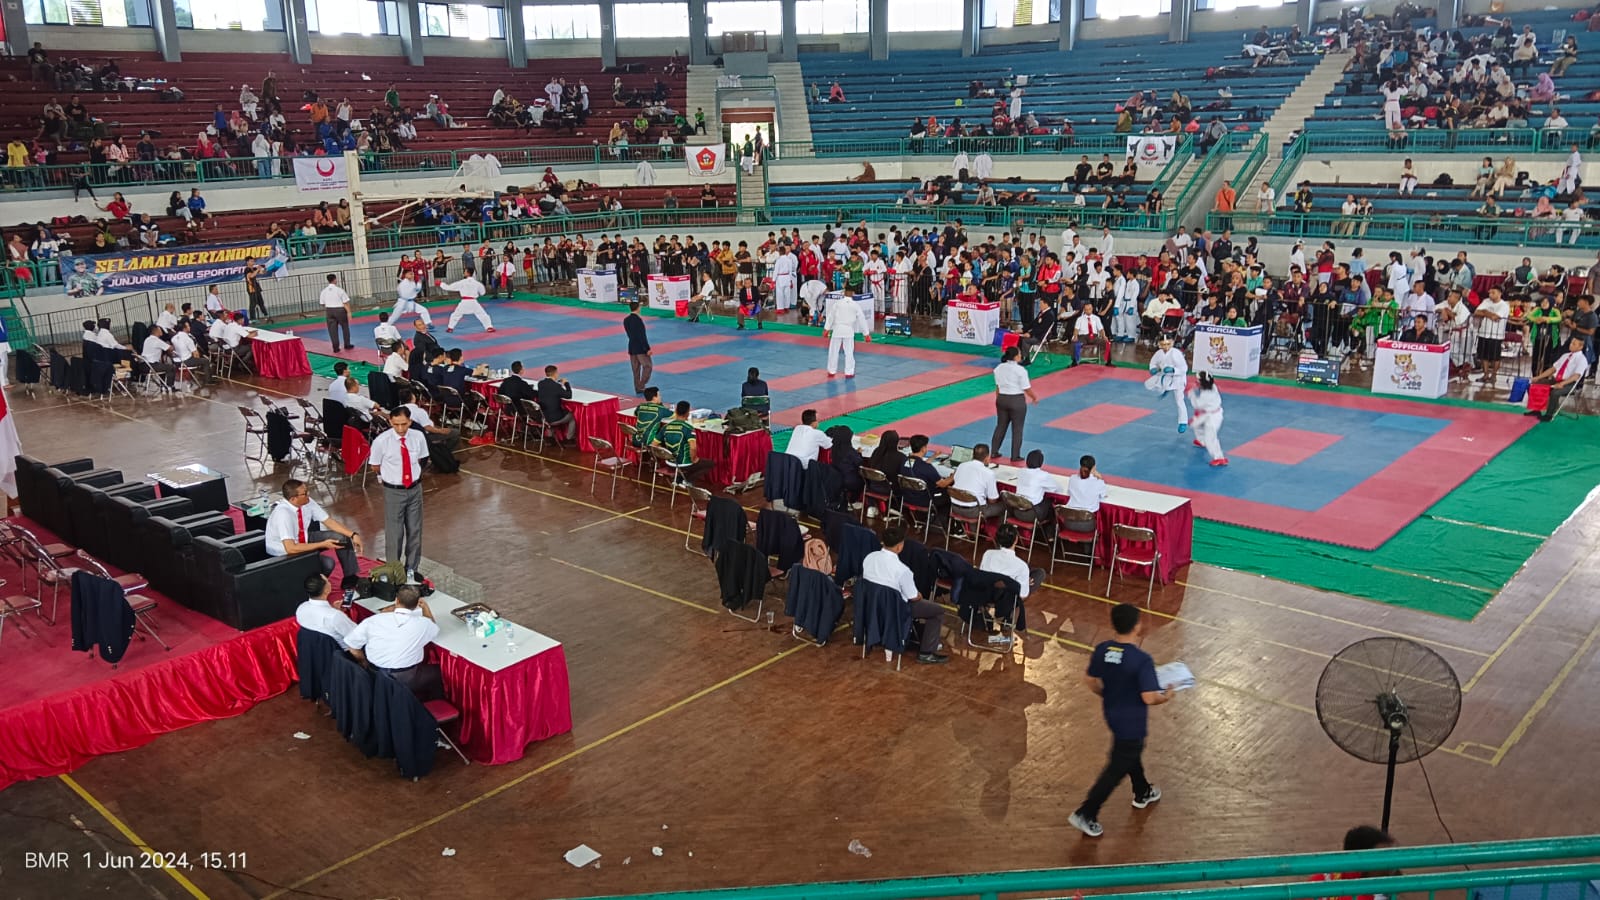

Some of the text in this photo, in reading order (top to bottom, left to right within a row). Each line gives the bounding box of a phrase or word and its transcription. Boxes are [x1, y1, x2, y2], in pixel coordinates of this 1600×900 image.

[95, 245, 272, 274] SELAMAT BERTANDING
[108, 265, 258, 288] JUNJUNG TINGGI SPORTIFIT
[1206, 326, 1238, 335] OFFICIAL
[1391, 342, 1430, 352] OFFICIAL
